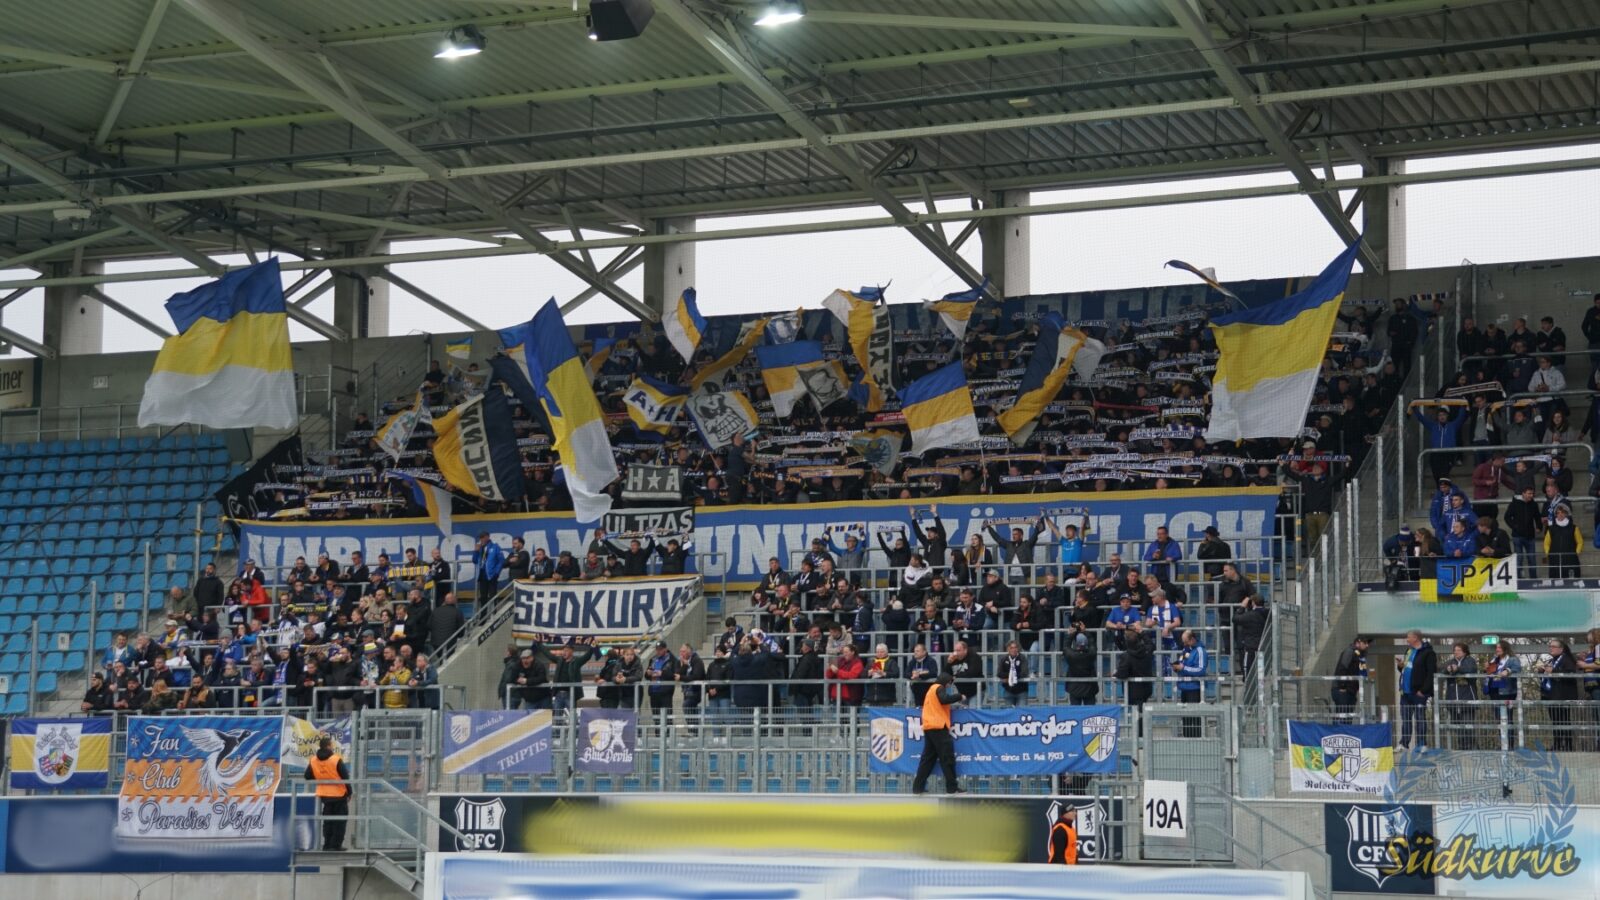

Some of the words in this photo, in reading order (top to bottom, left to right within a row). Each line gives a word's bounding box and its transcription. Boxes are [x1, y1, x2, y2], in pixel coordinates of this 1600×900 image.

[514, 586, 690, 630] SÜDKURV
[142, 723, 180, 758] Fan
[497, 738, 549, 772] TRIPTIS
[578, 747, 604, 764] Blue
[600, 748, 633, 764] Devils
[139, 761, 183, 791] Club
[138, 800, 212, 836] Paradies
[212, 801, 267, 837] Vögel
[1146, 798, 1184, 830] 19A
[463, 833, 496, 849] CFC
